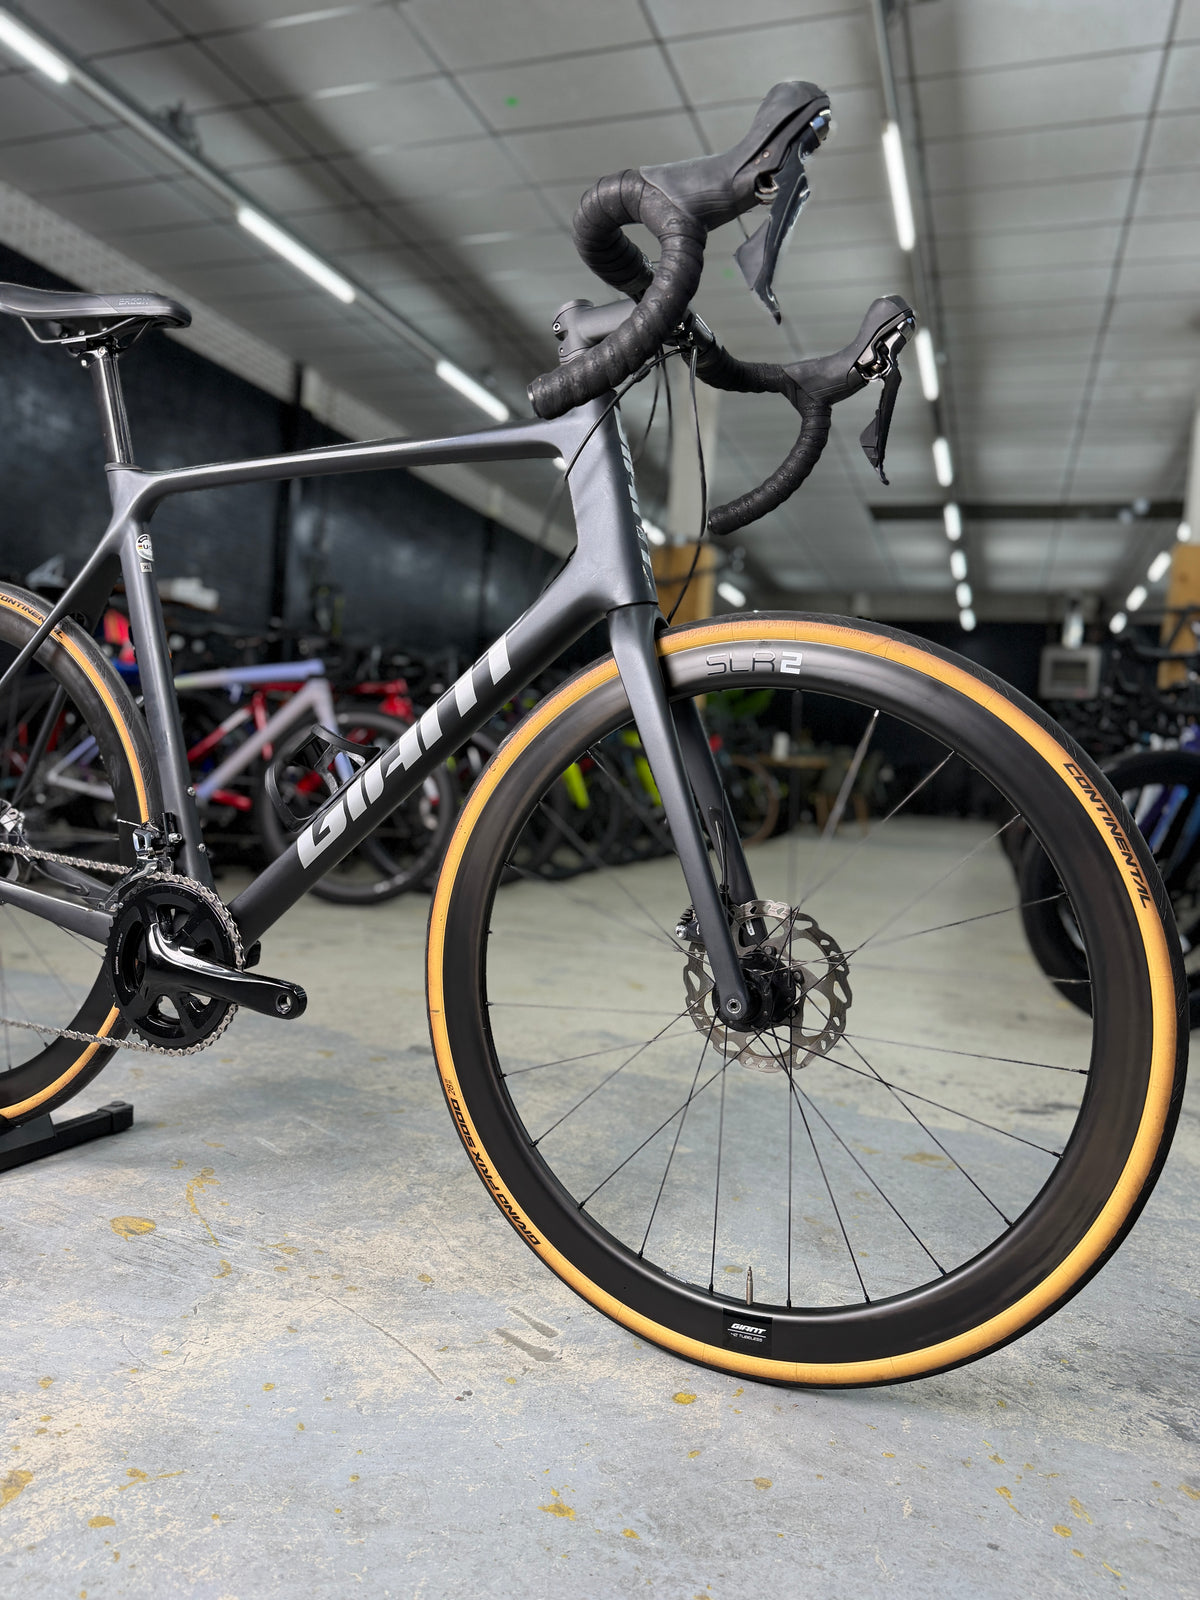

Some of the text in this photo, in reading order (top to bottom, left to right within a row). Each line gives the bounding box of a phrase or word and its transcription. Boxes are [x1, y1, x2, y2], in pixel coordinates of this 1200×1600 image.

[297, 612, 527, 869] GIANT
[1063, 762, 1151, 909] CONTINENTAL
[450, 1097, 476, 1148] 5000
[472, 1150, 500, 1191] PRIX
[496, 1192, 542, 1246] GRAND
[730, 1323, 767, 1335] GIANT
